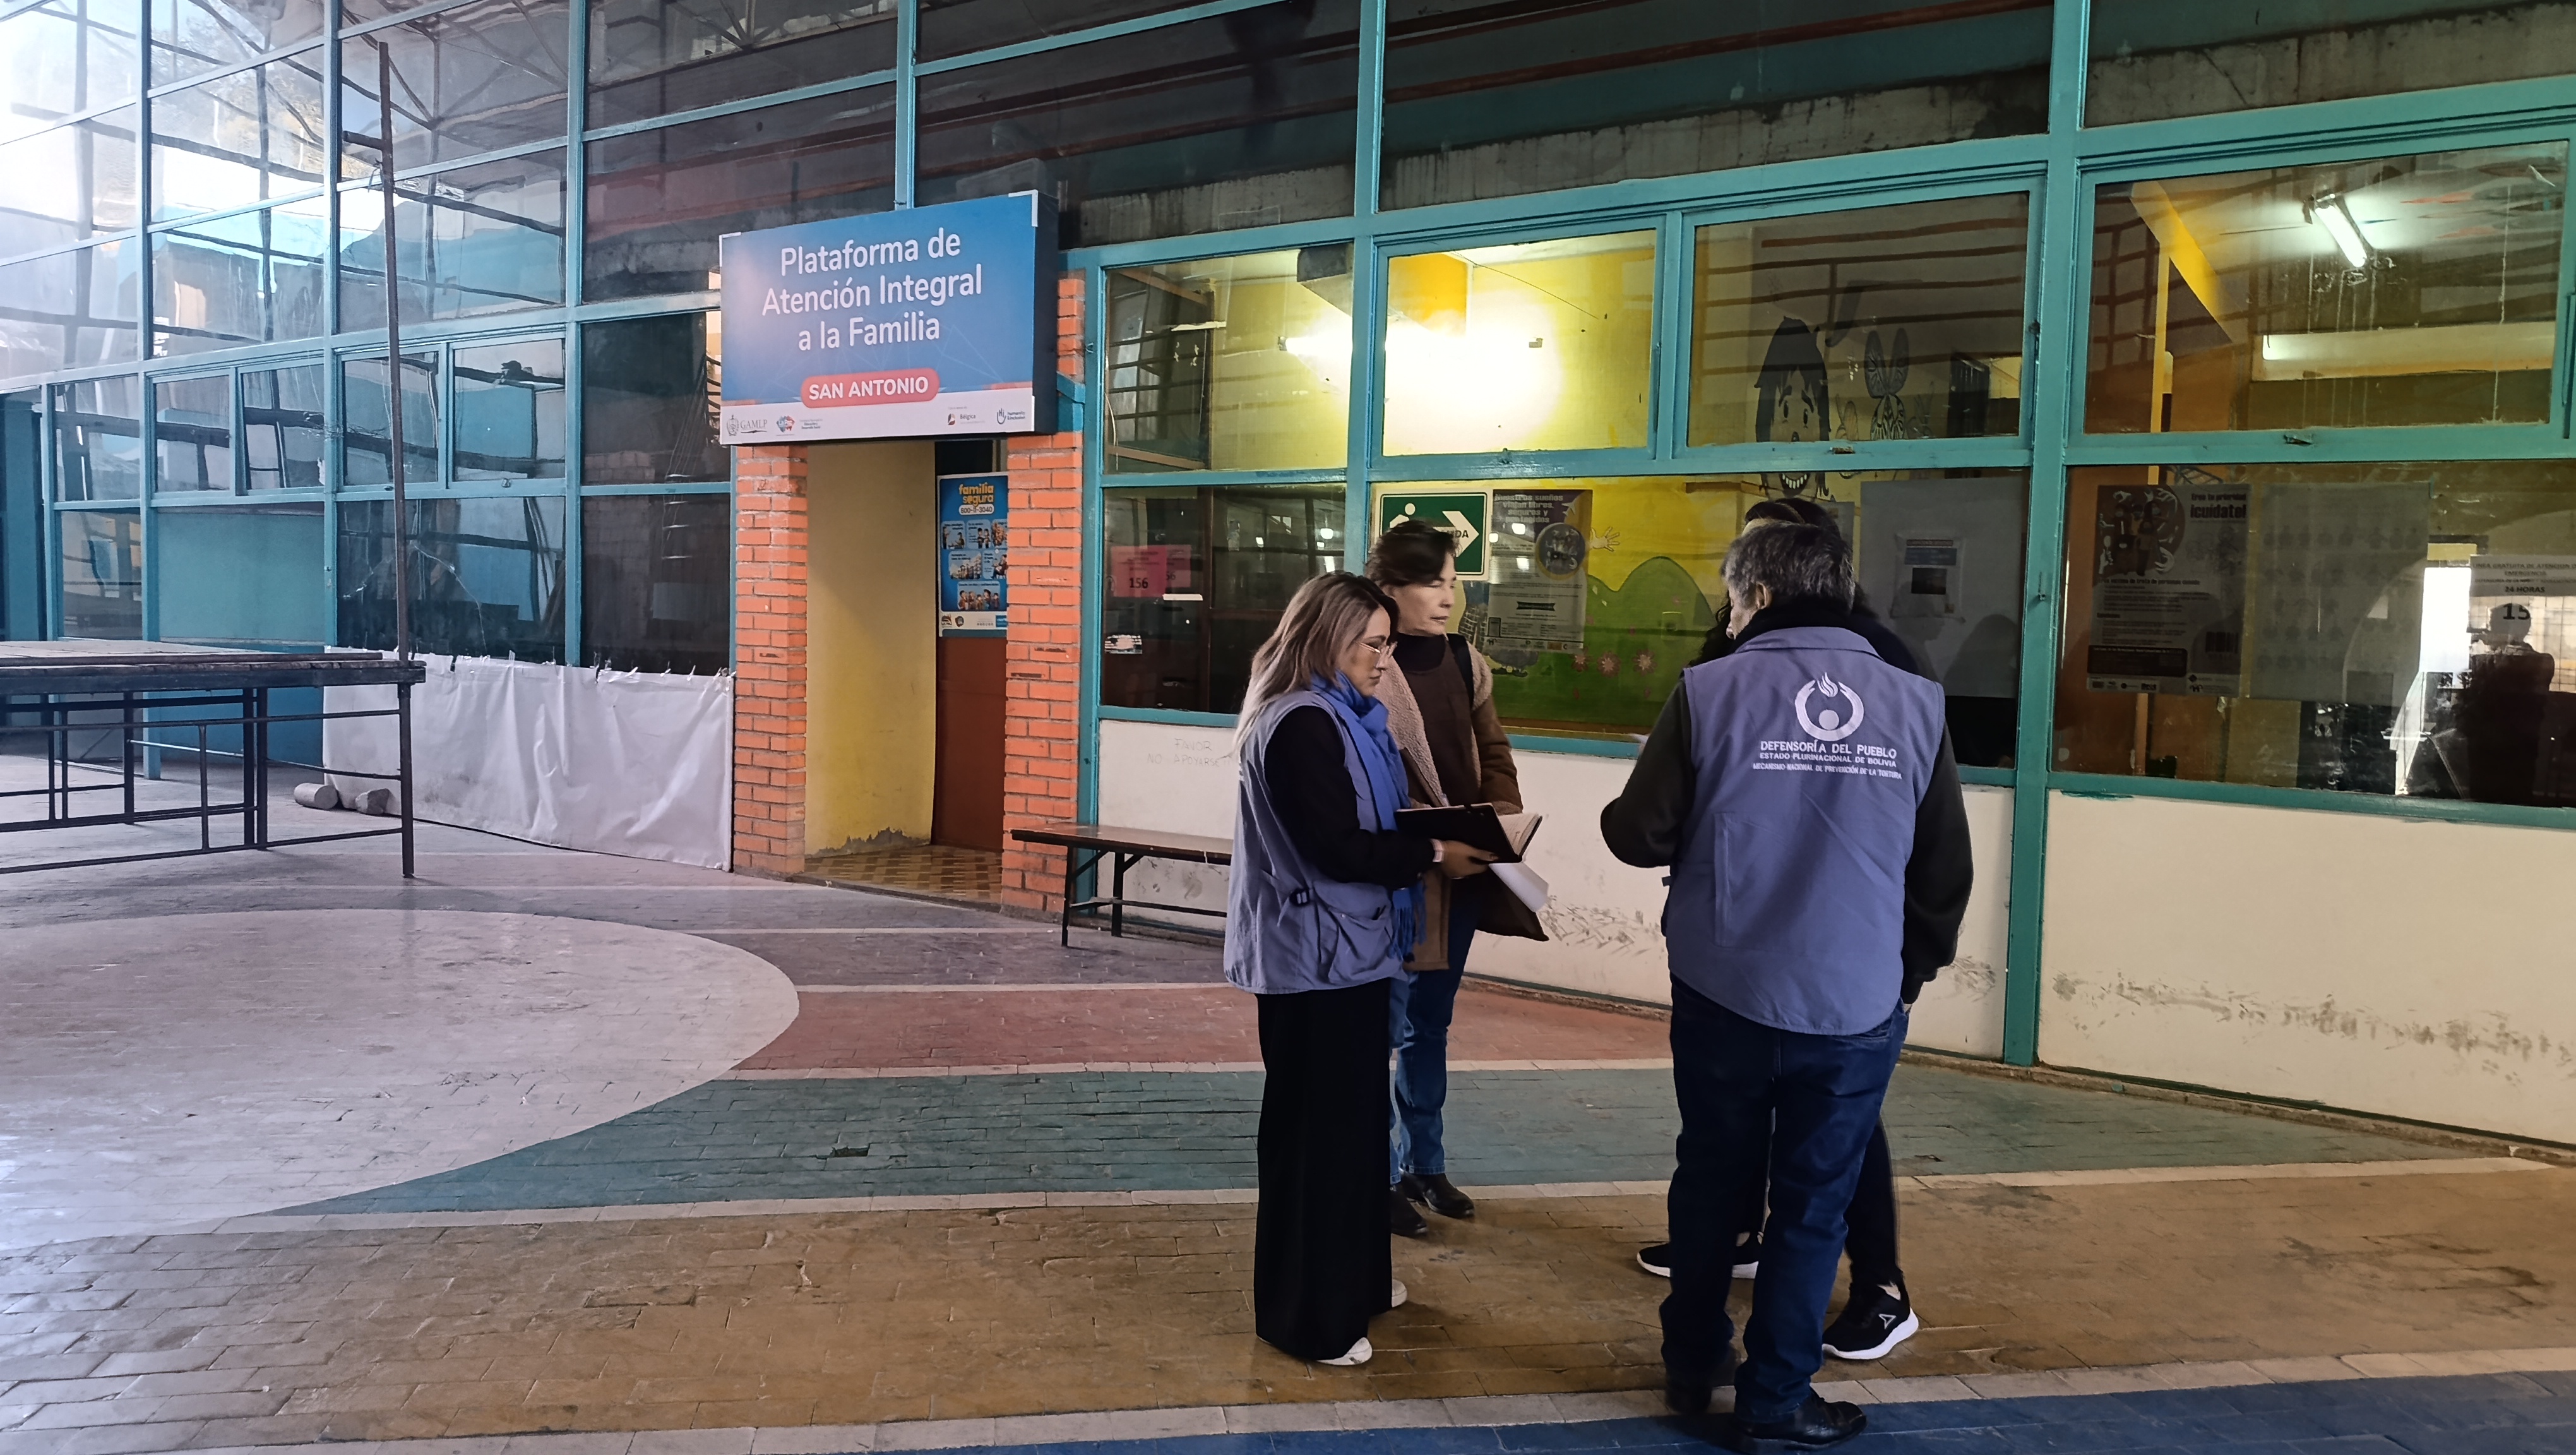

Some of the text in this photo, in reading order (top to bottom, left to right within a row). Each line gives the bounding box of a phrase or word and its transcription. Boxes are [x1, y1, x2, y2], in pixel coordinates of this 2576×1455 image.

[781, 227, 960, 277] Plataforma de
[762, 263, 982, 316] Atención Integral
[799, 310, 939, 351] a la Familia
[809, 376, 929, 400] SAN ANTONIO
[740, 419, 768, 429] GAMLP
[958, 482, 994, 494] familia
[963, 494, 994, 507] segura
[1129, 577, 1148, 589] 156
[1174, 738, 1212, 751] FAVOR
[1760, 739, 1897, 759] DEFENSORÍA DEL PUEBLO
[1147, 753, 1162, 764] NO
[1792, 752, 1852, 763] PLURINACIONAL
[1868, 757, 1897, 768] BOLIVIA
[1753, 762, 1786, 770] MECANISMO
[1786, 763, 1813, 771] NACIONAL
[1868, 768, 1876, 776] LA
[1877, 769, 1902, 779] TORTURA
